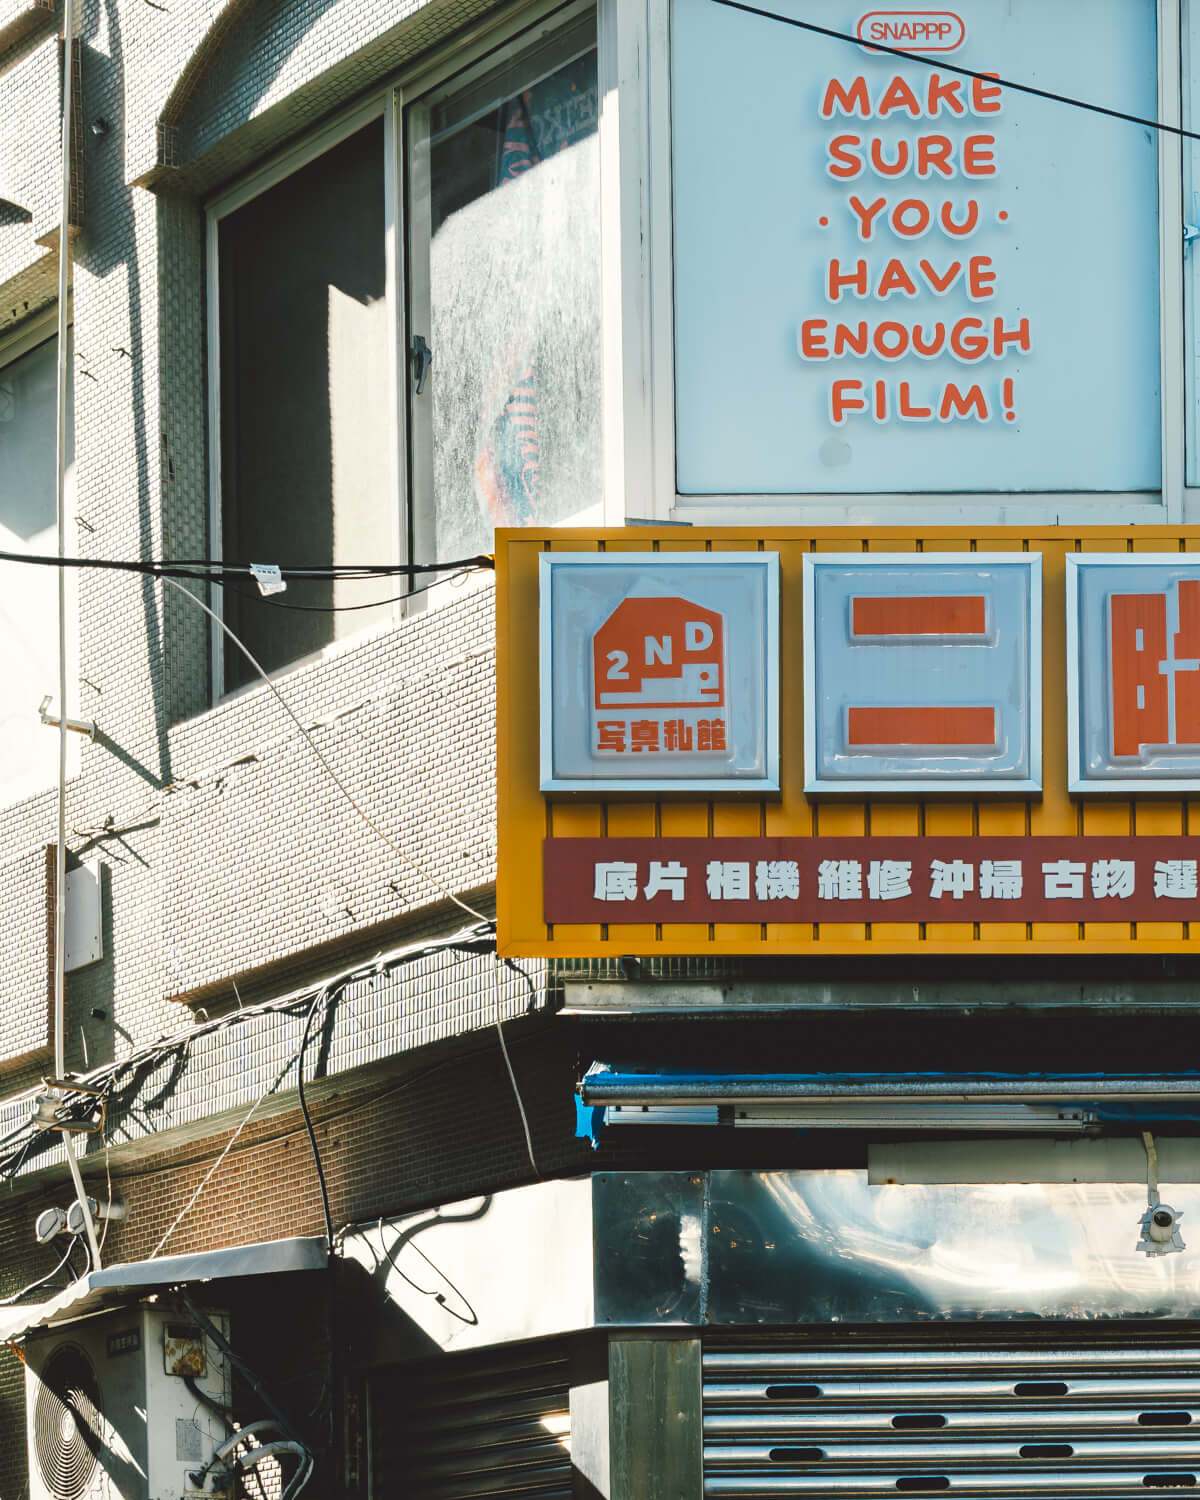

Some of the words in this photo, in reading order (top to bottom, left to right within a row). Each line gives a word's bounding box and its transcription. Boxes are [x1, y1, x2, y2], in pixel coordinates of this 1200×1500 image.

[870, 22, 952, 40] SNAPPP
[822, 73, 1002, 116] MAKE
[828, 135, 996, 177] SURE
[828, 256, 996, 300] HAVE
[802, 318, 1030, 359] ENOUGH
[832, 379, 1015, 422] FILM!
[605, 621, 714, 680] 2ND
[593, 860, 688, 901] 底片
[706, 860, 800, 900] 相機
[817, 859, 912, 900] 維修
[929, 858, 1024, 900] 沖掃
[1041, 858, 1136, 899] 古物
